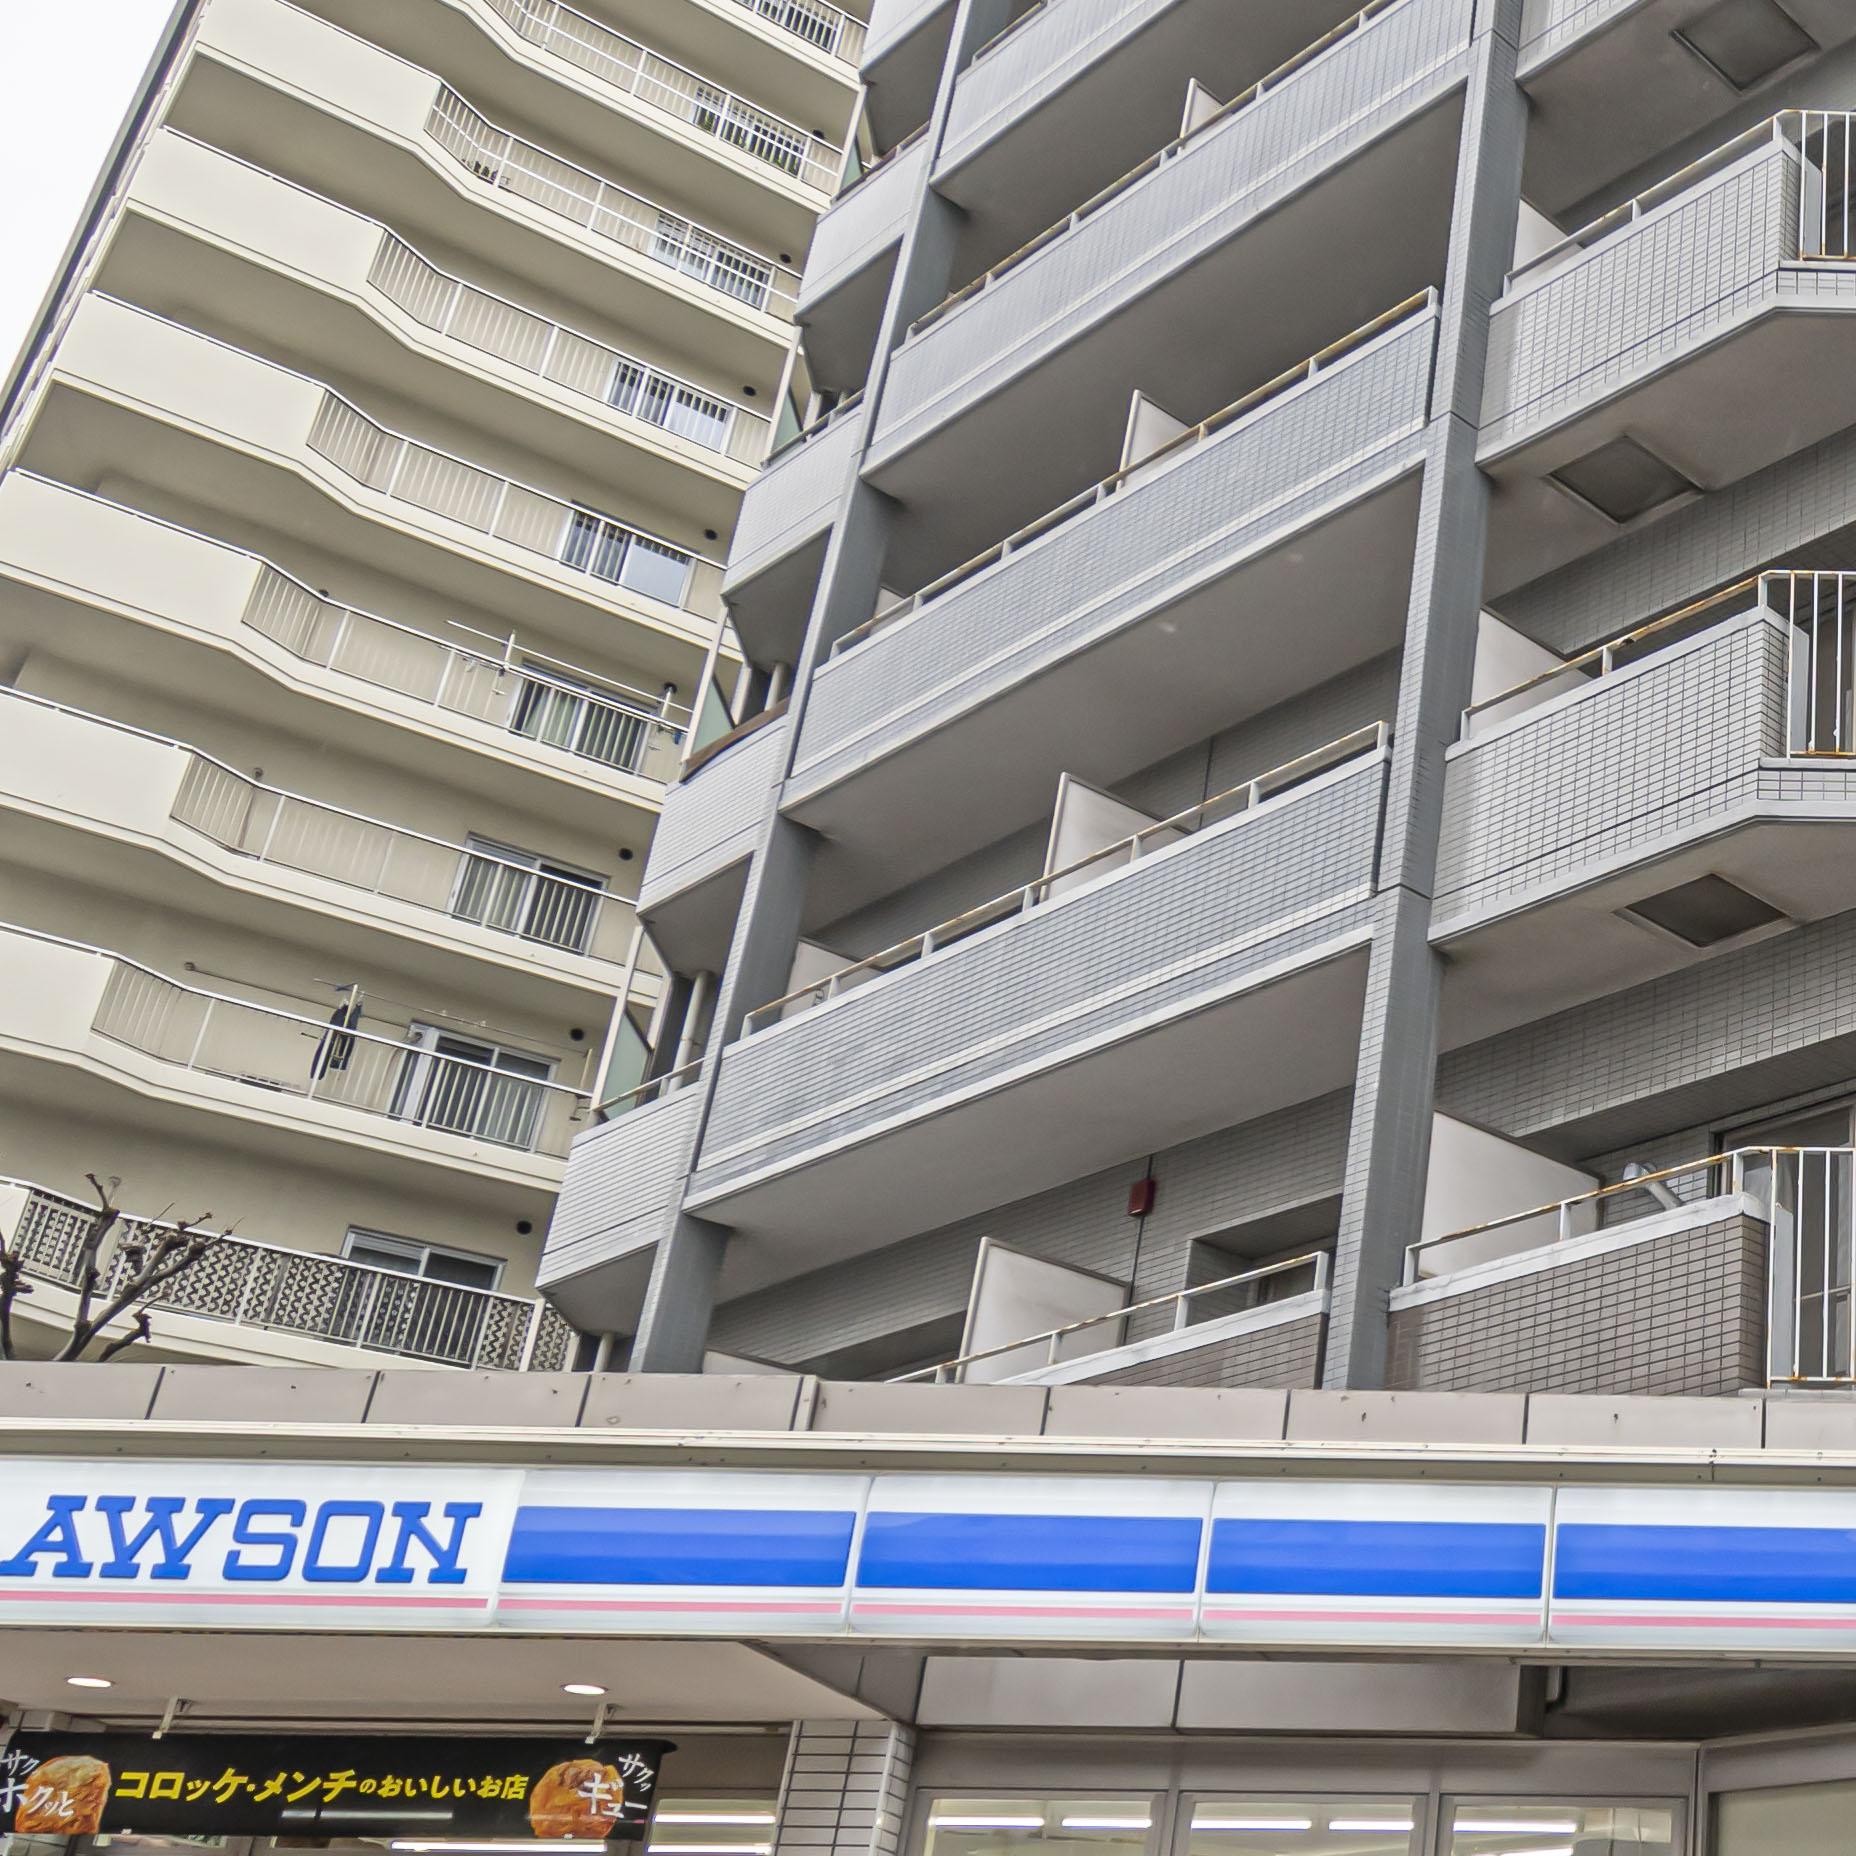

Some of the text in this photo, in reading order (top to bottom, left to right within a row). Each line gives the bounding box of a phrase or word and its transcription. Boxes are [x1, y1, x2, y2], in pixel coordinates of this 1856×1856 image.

[0, 1495, 483, 1584] AWSON
[115, 1768, 530, 1803] コロッケ・メンチのおいしいお店
